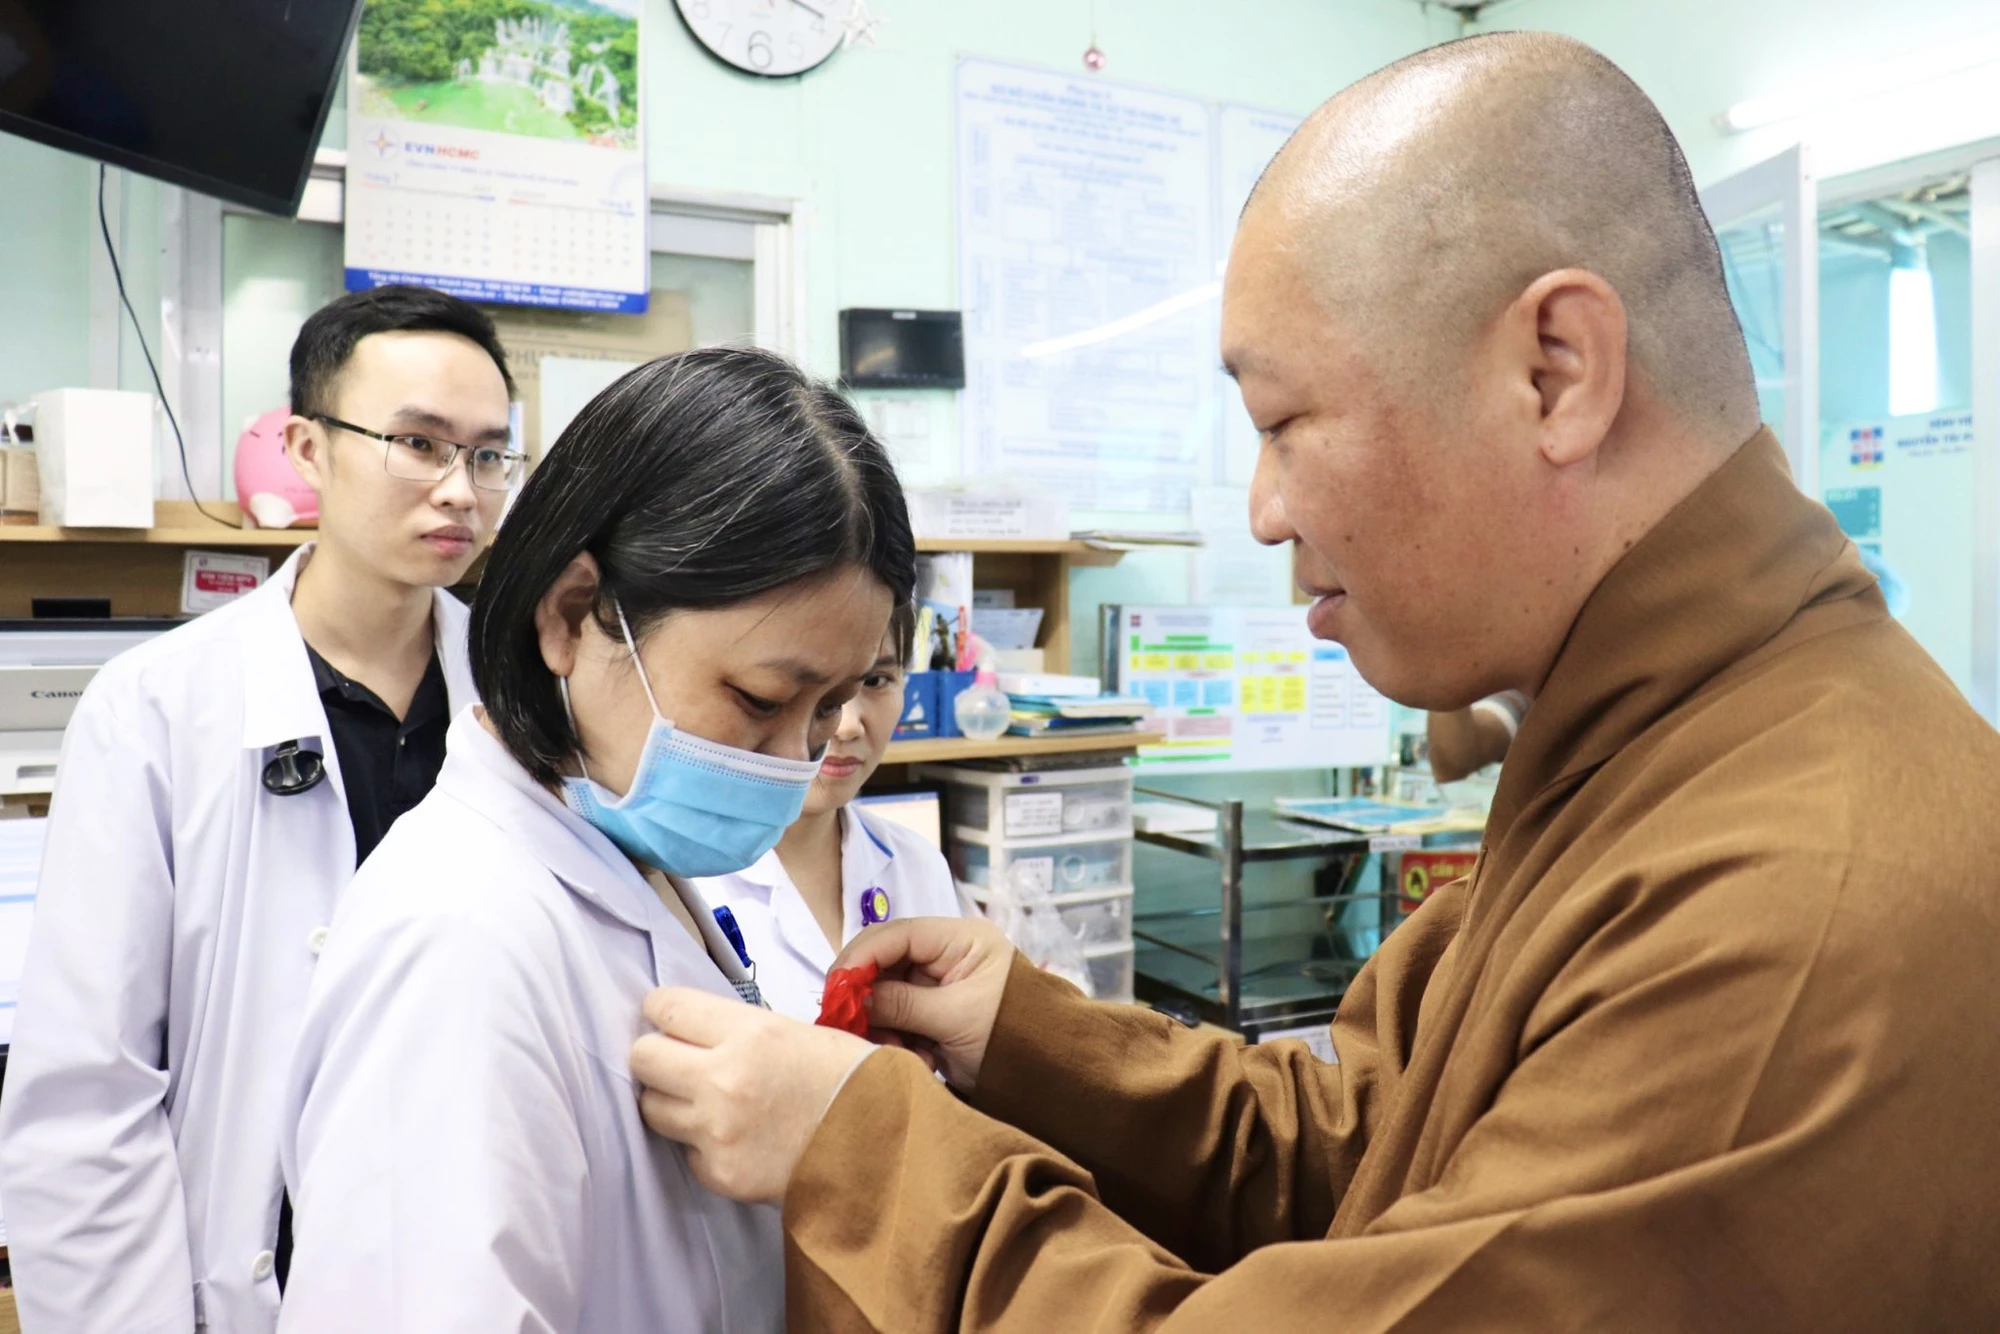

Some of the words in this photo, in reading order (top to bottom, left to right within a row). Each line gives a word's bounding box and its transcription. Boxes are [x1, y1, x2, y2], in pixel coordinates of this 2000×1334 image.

[716, 21, 734, 50] 7
[748, 30, 773, 70] 6
[787, 31, 805, 62] 5
